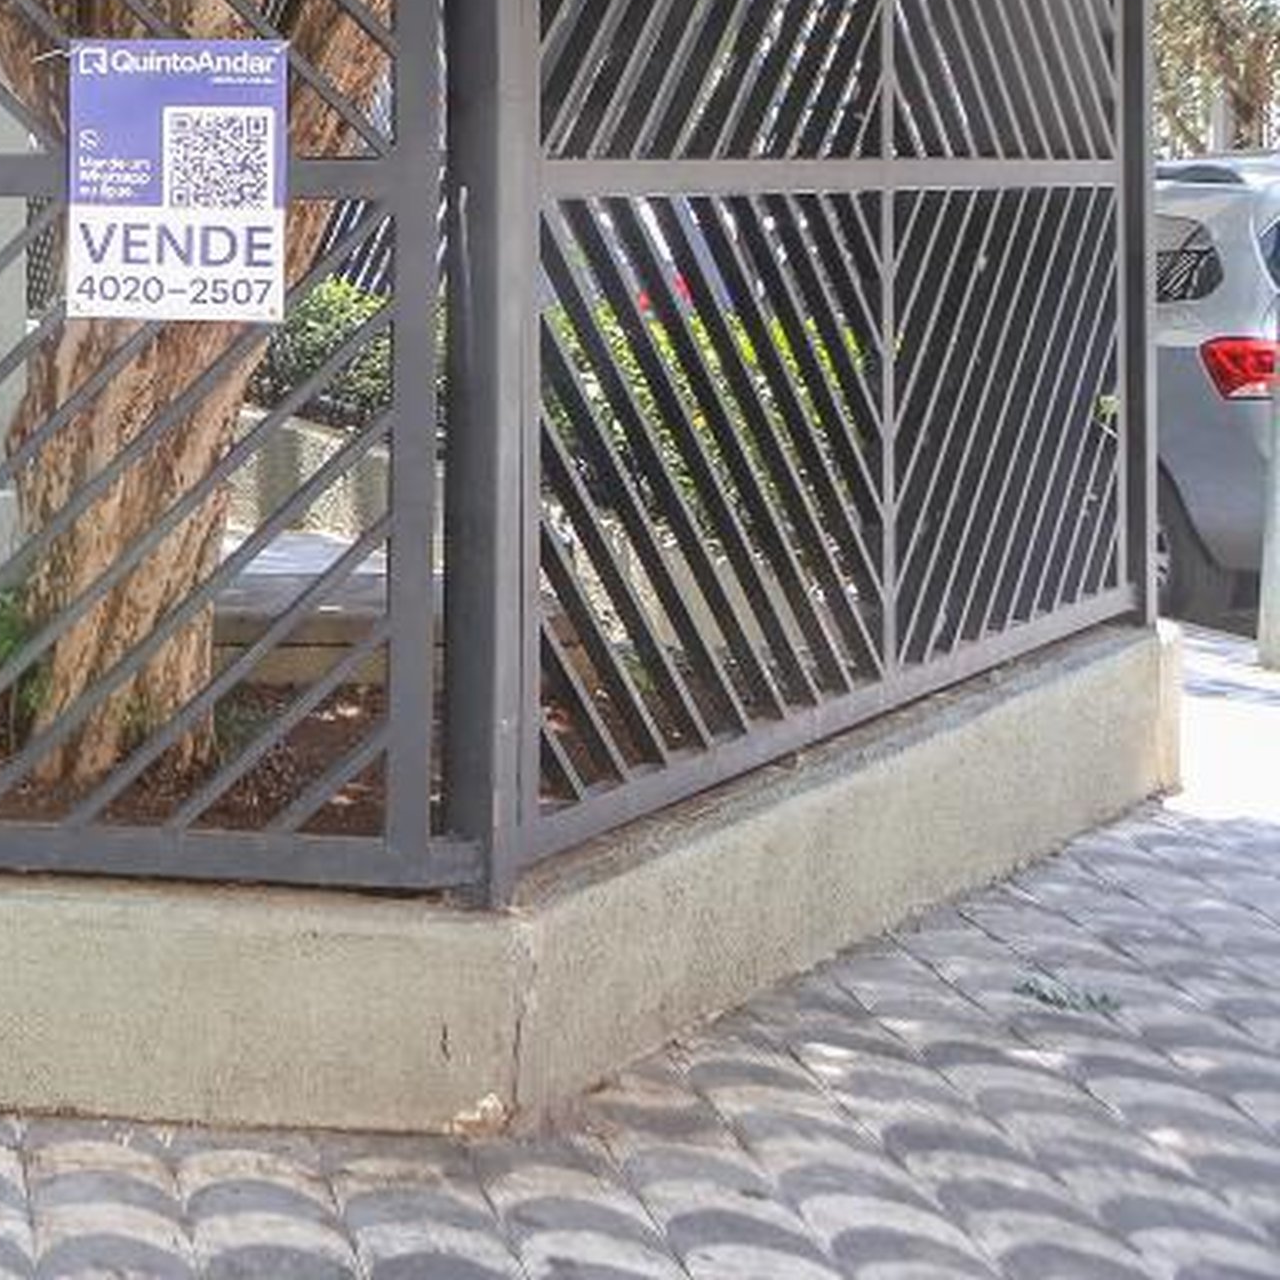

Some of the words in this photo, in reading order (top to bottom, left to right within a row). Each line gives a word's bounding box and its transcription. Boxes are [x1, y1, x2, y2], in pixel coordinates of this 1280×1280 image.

[111, 48, 276, 73] QuintoAndar
[78, 222, 274, 267] VENDE
[76, 275, 274, 305] 4020-2507
